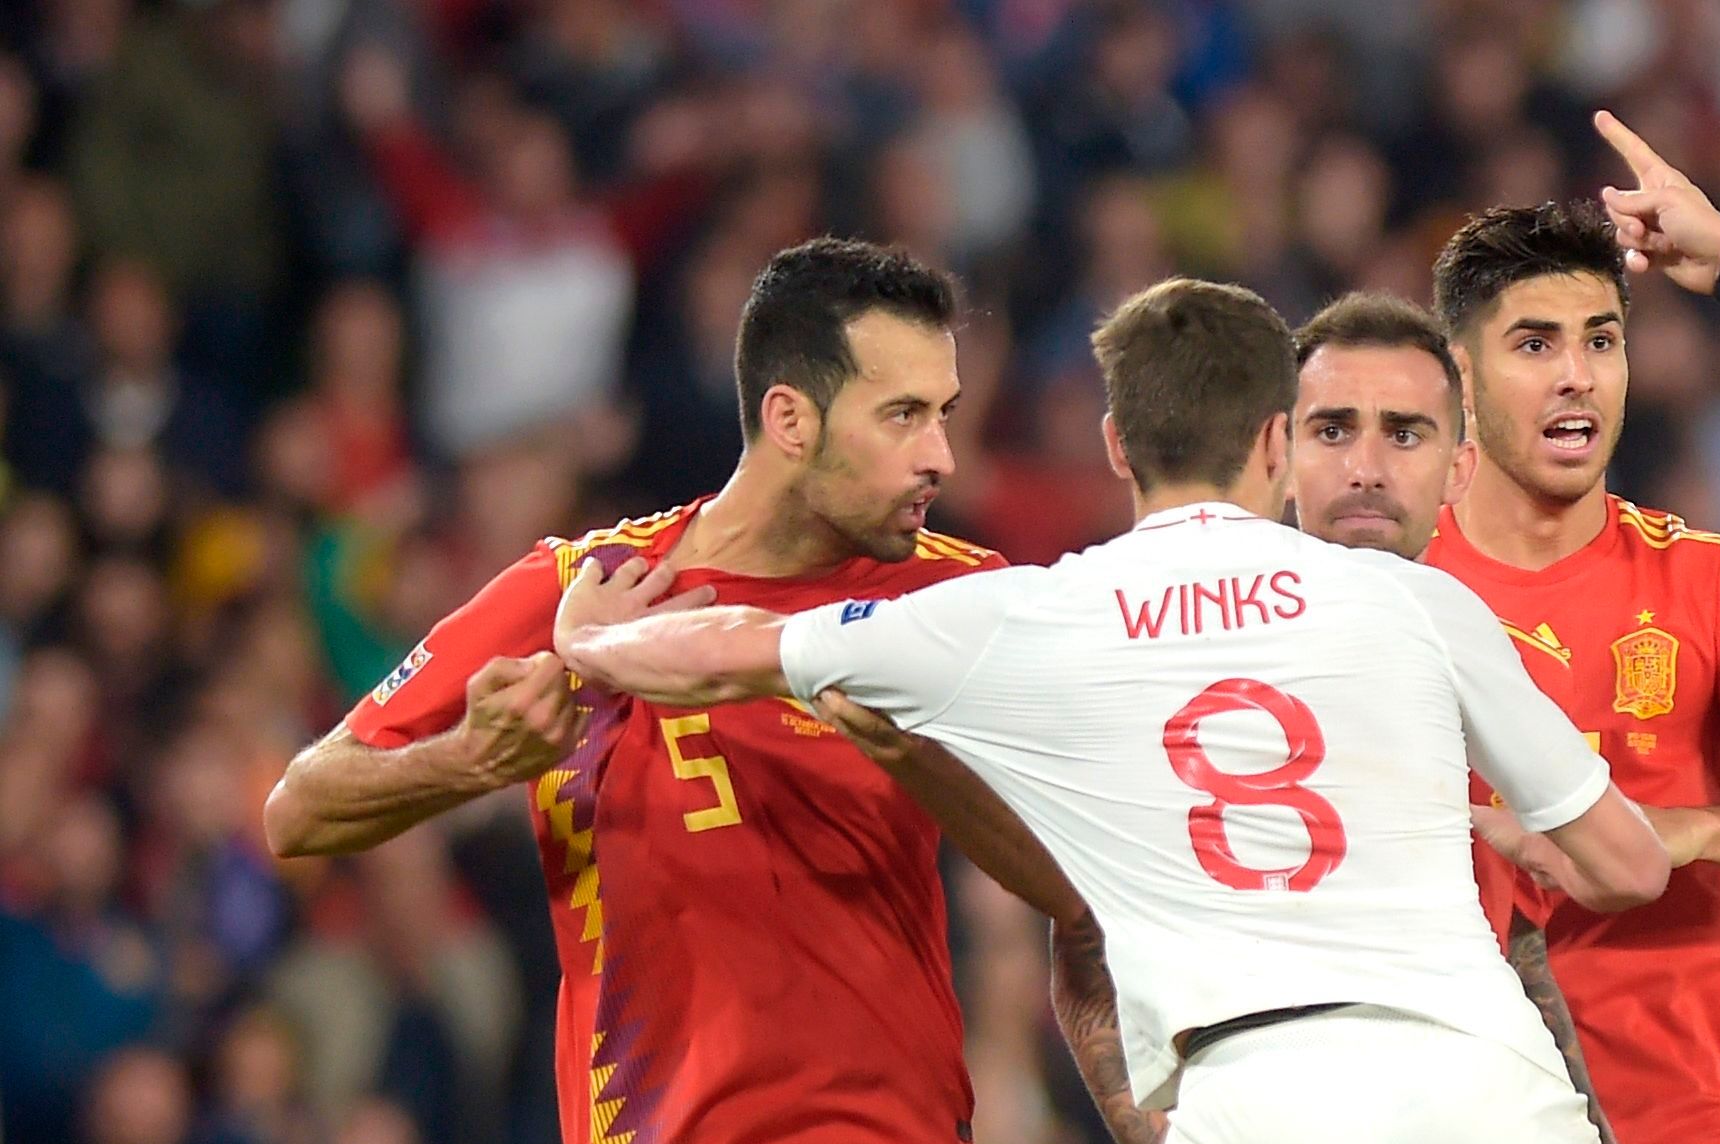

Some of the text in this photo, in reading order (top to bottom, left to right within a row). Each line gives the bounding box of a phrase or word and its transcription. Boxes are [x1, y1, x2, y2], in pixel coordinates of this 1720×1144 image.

[1114, 570, 1307, 639] WINKS
[660, 712, 742, 832] 5
[1162, 678, 1348, 892] 8
